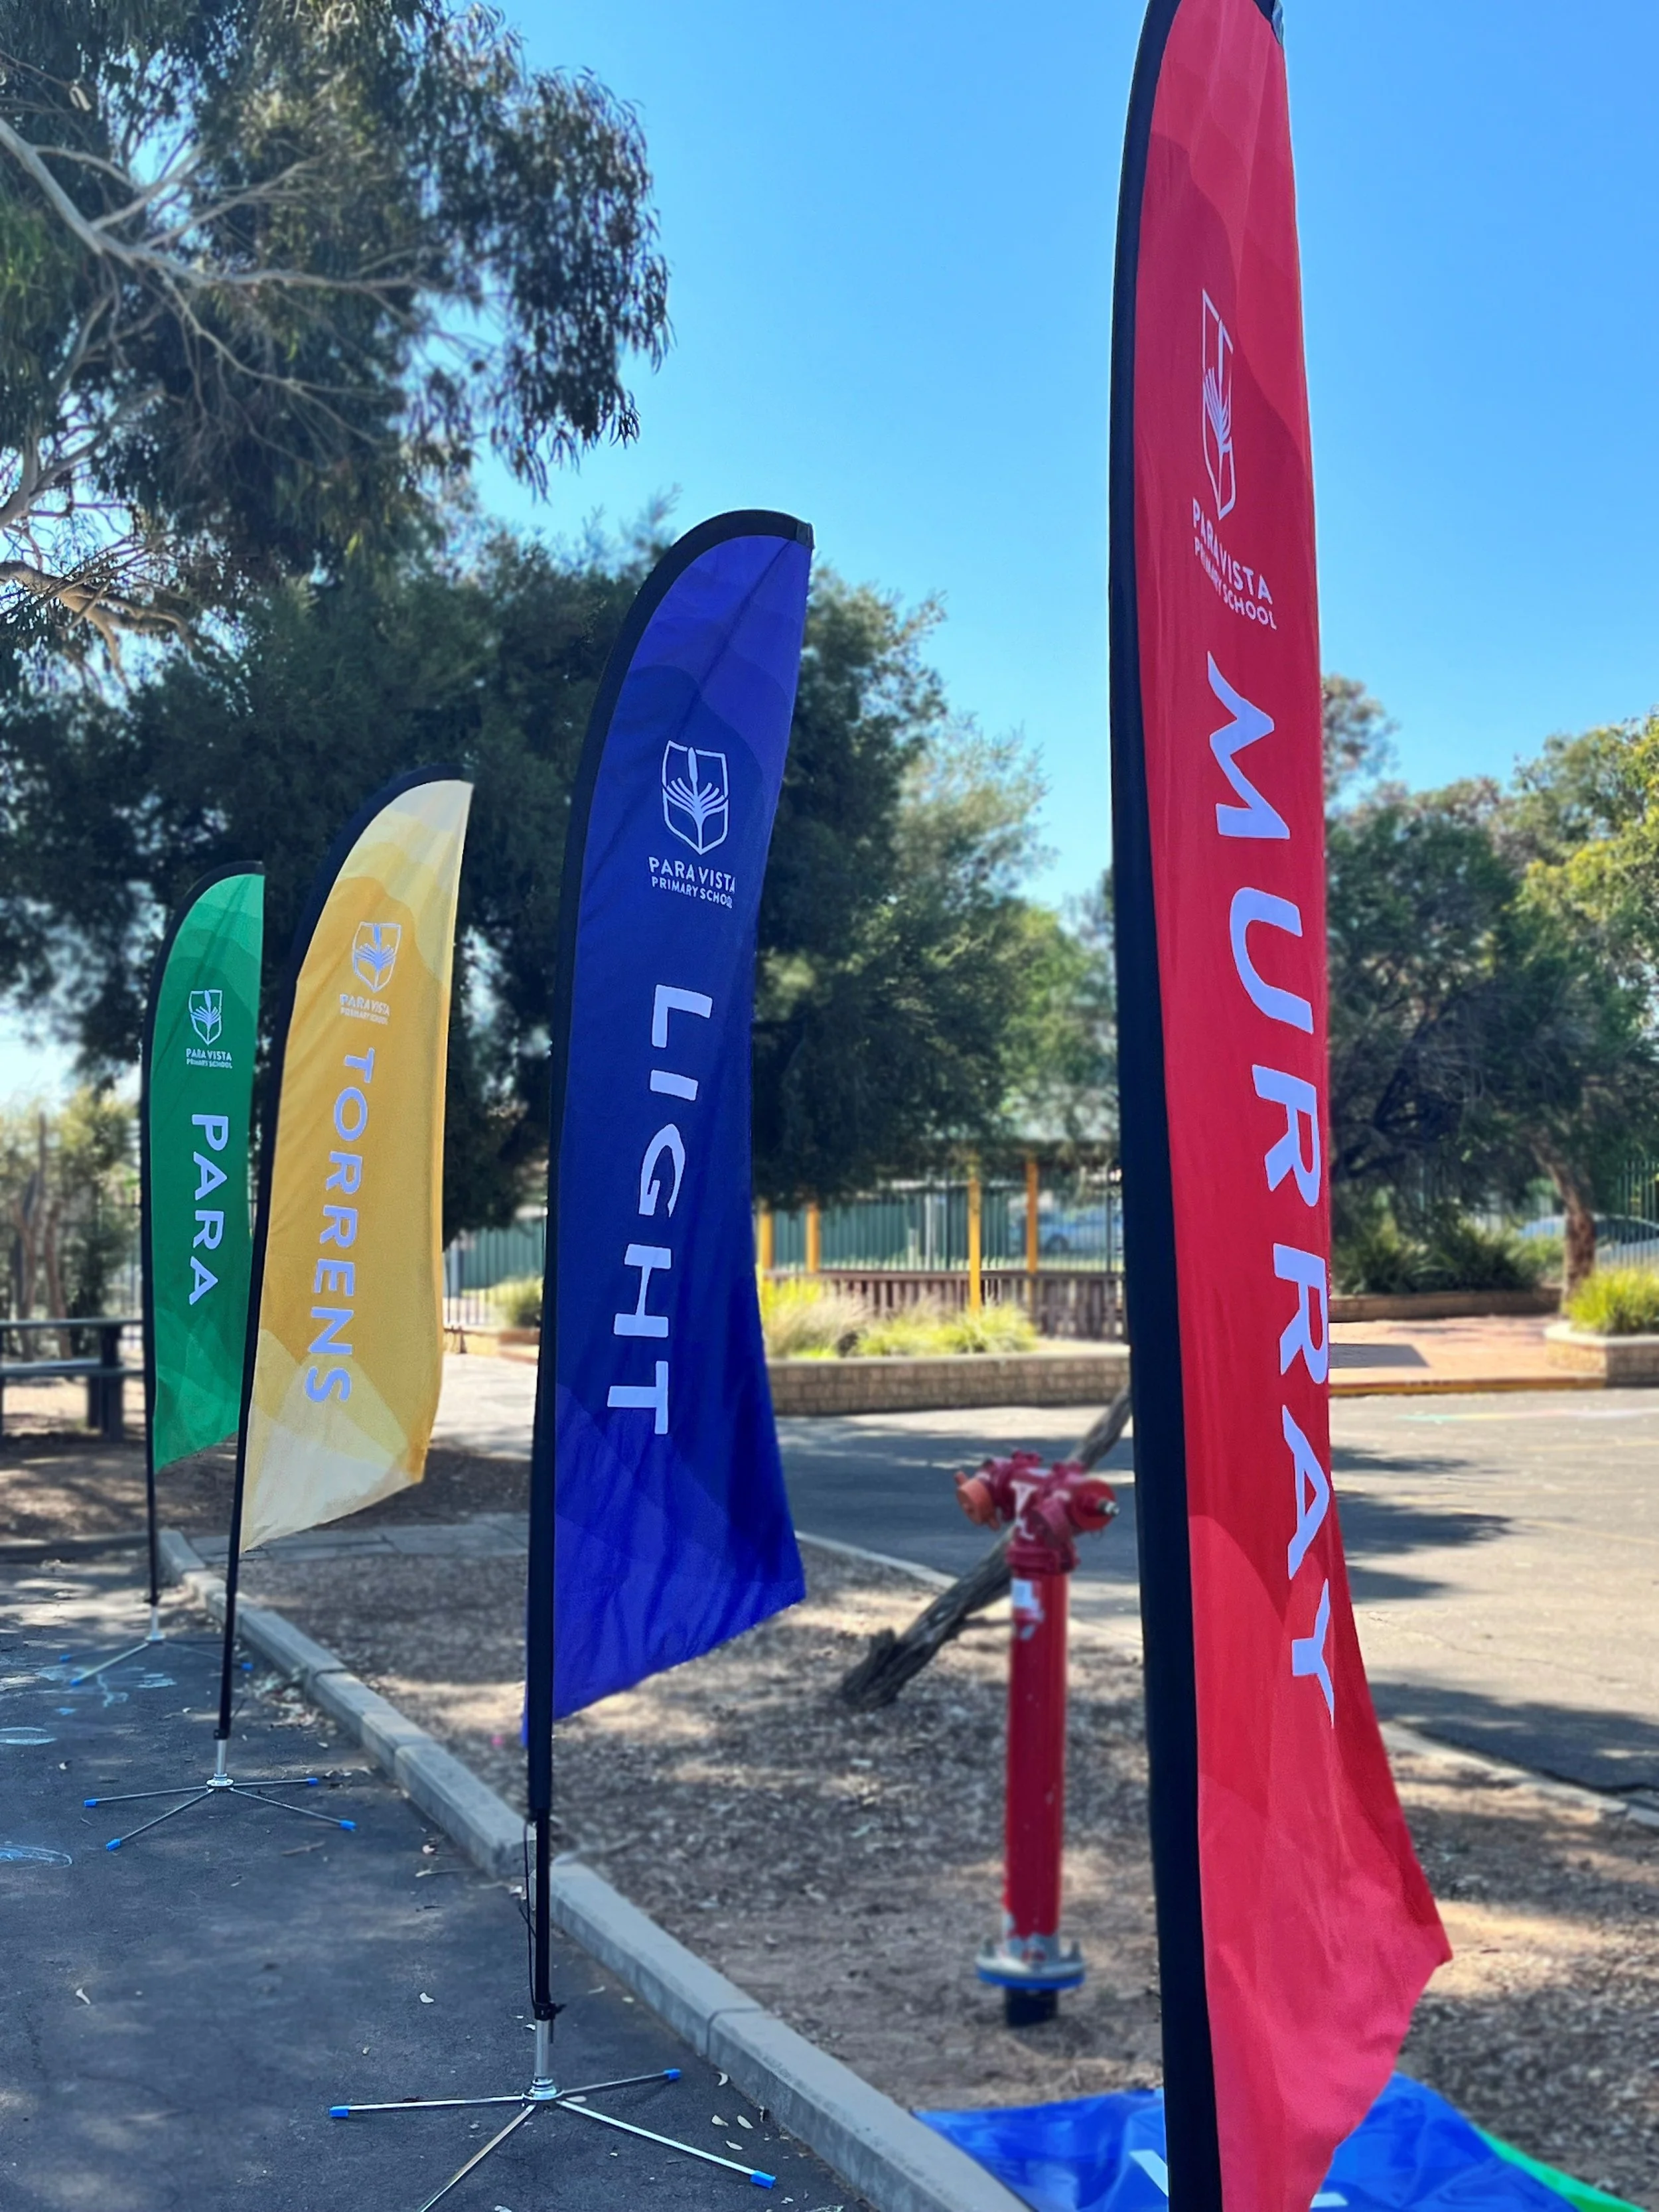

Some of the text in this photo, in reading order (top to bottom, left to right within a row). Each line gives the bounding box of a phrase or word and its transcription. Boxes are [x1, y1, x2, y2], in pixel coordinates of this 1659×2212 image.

[1192, 497, 1273, 605] PARA VISTA
[1222, 583, 1277, 630] SCHOOL
[649, 856, 735, 895] PARA VISTA
[652, 875, 699, 898] PRIMARY
[207, 1050, 232, 1061] VISTA
[188, 1114, 229, 1305] PARA
[305, 1047, 375, 1403] TORRENS
[607, 984, 713, 1435] LIGHT
[1206, 650, 1335, 1728] MURRAY
